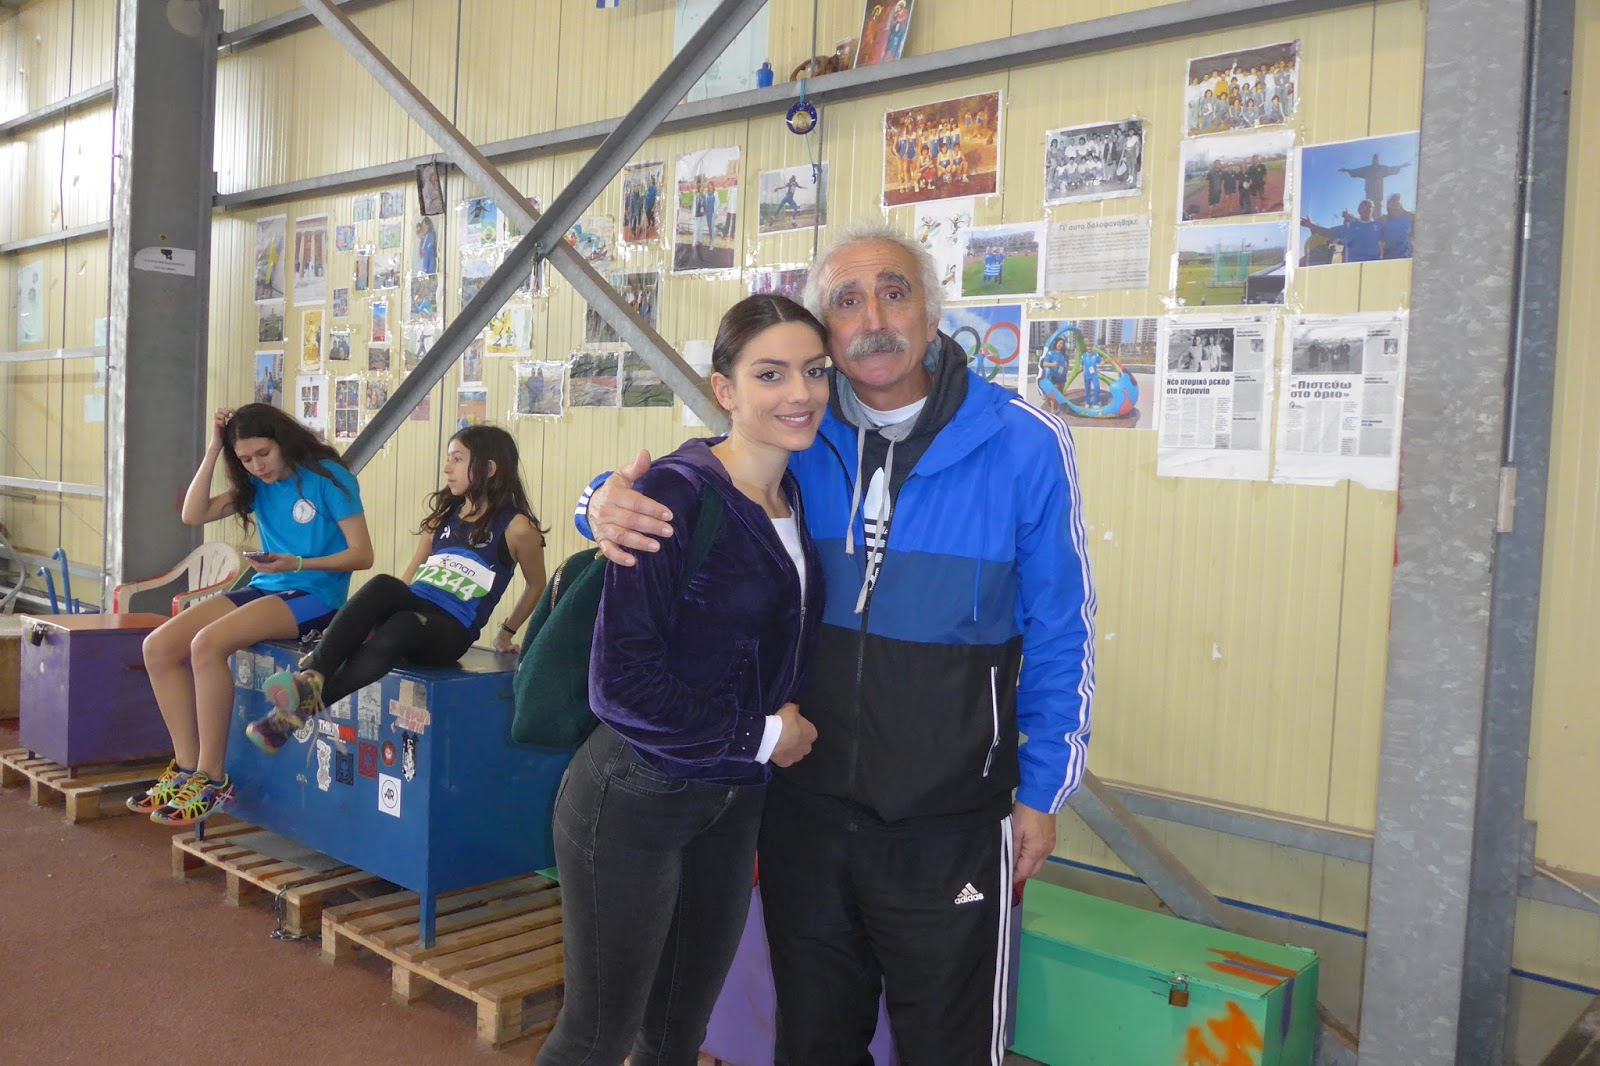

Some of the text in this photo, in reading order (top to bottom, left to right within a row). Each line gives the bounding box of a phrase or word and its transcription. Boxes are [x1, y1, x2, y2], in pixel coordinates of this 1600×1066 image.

[1166, 378, 1179, 386] Νέο
[1180, 378, 1207, 387] ατομικό
[1208, 378, 1230, 387] ρεκόρ
[1291, 379, 1352, 389] «Πιστεύω
[1166, 386, 1210, 395] στη Γερμανία
[1290, 389, 1350, 399] στο όριο»
[954, 892, 985, 905] adidas
